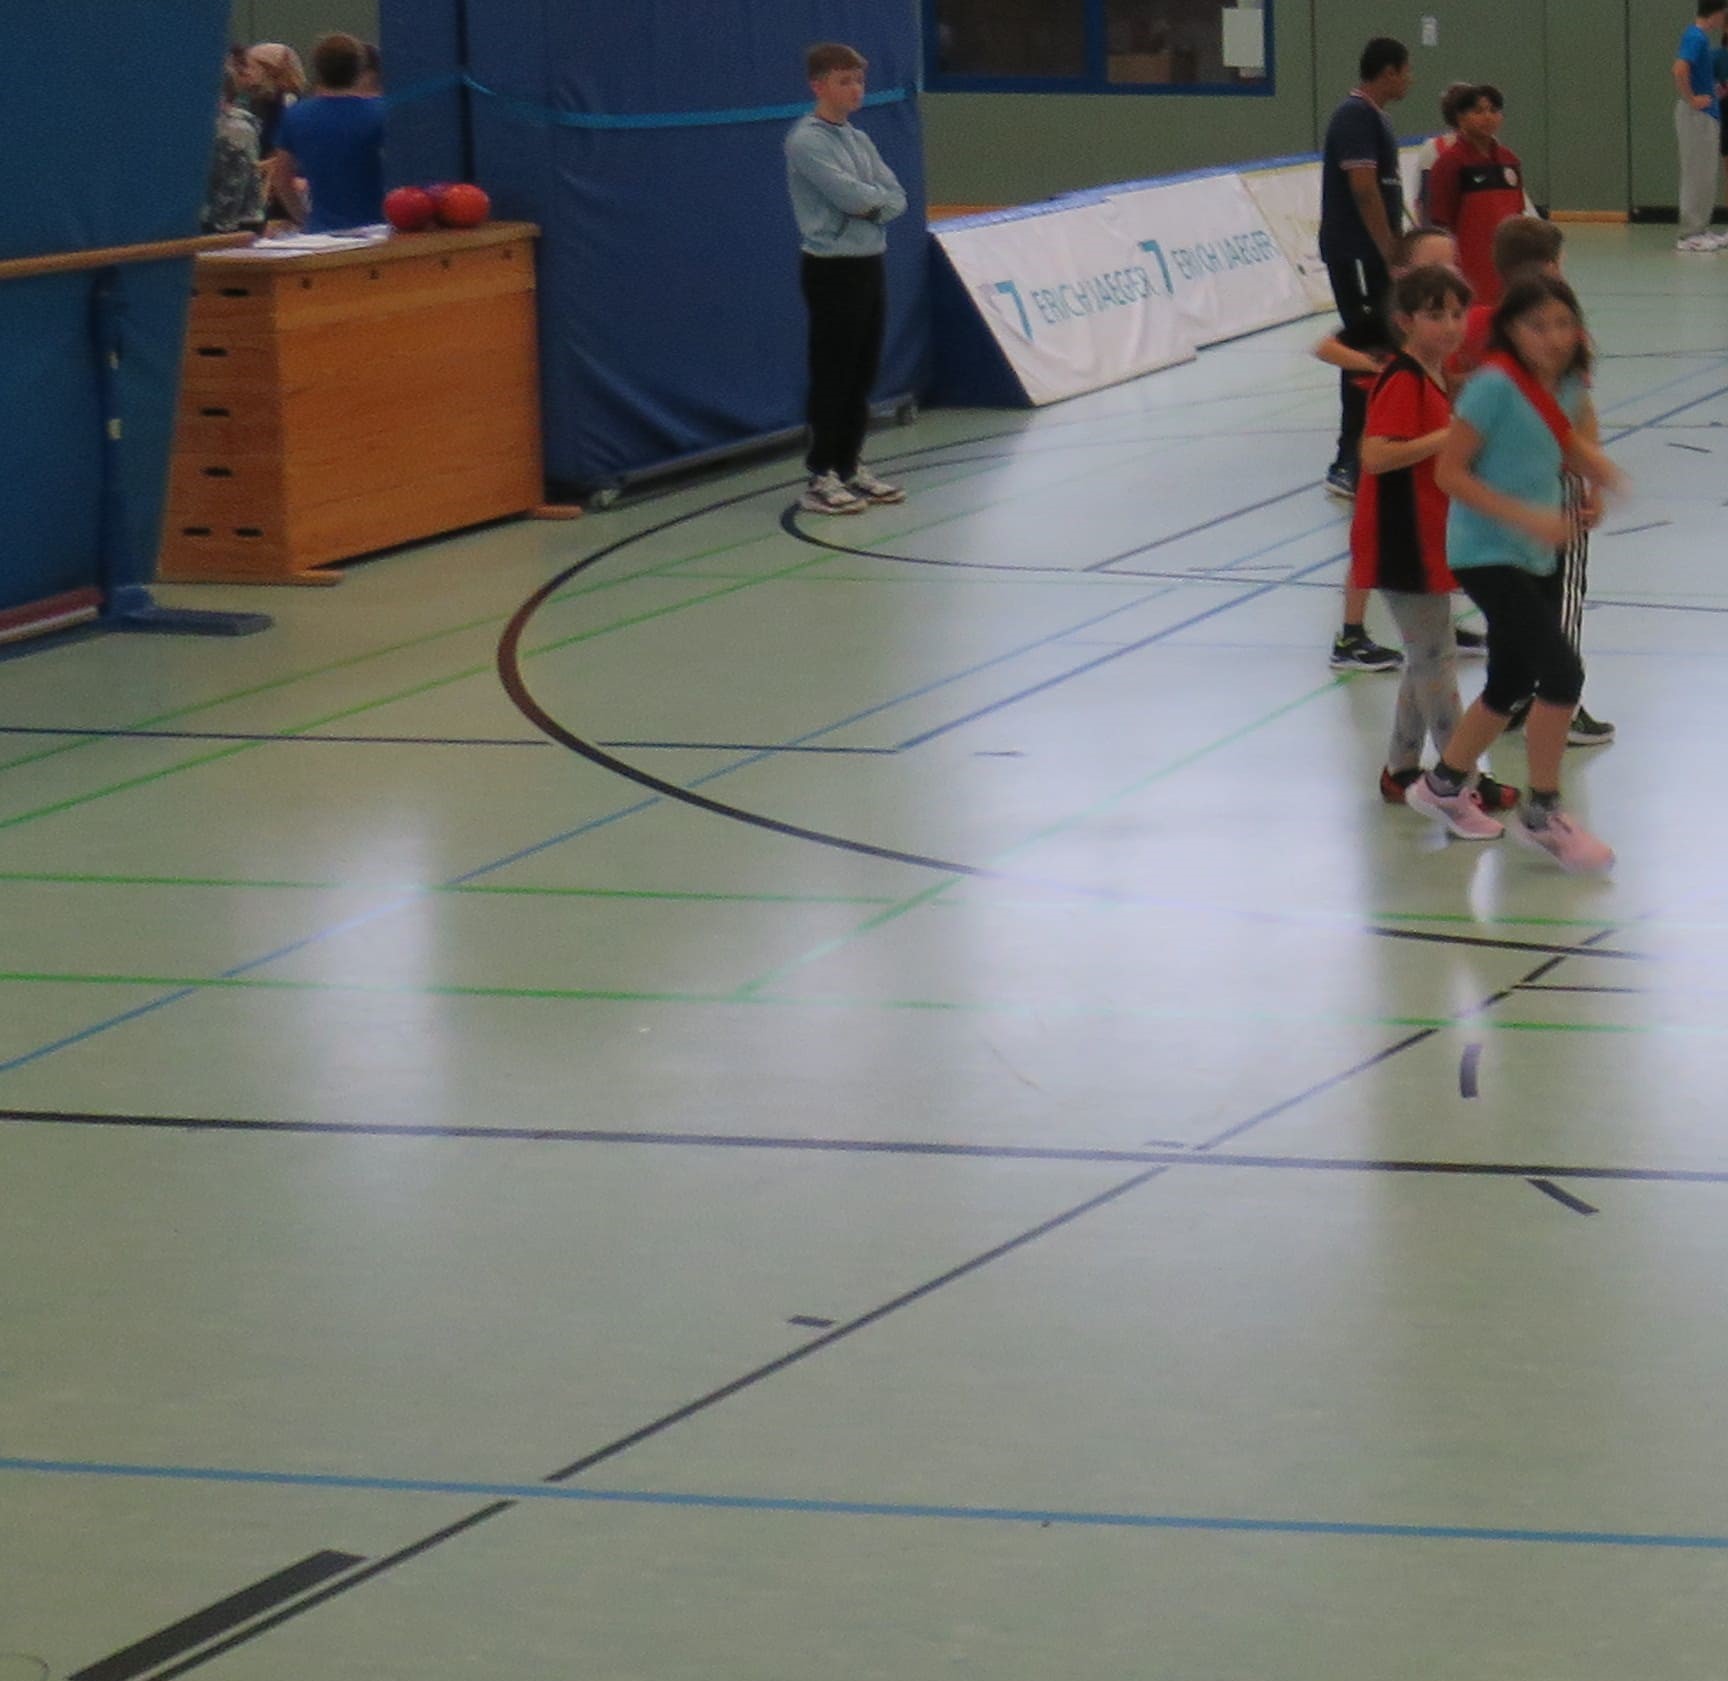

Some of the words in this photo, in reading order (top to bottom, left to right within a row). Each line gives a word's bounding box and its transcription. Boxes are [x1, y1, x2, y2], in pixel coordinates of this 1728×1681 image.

[1170, 241, 1219, 279] ERICH
[1223, 229, 1277, 271] JAEGER
[1030, 277, 1089, 324] ERICH
[1085, 266, 1160, 315] JAEGER
